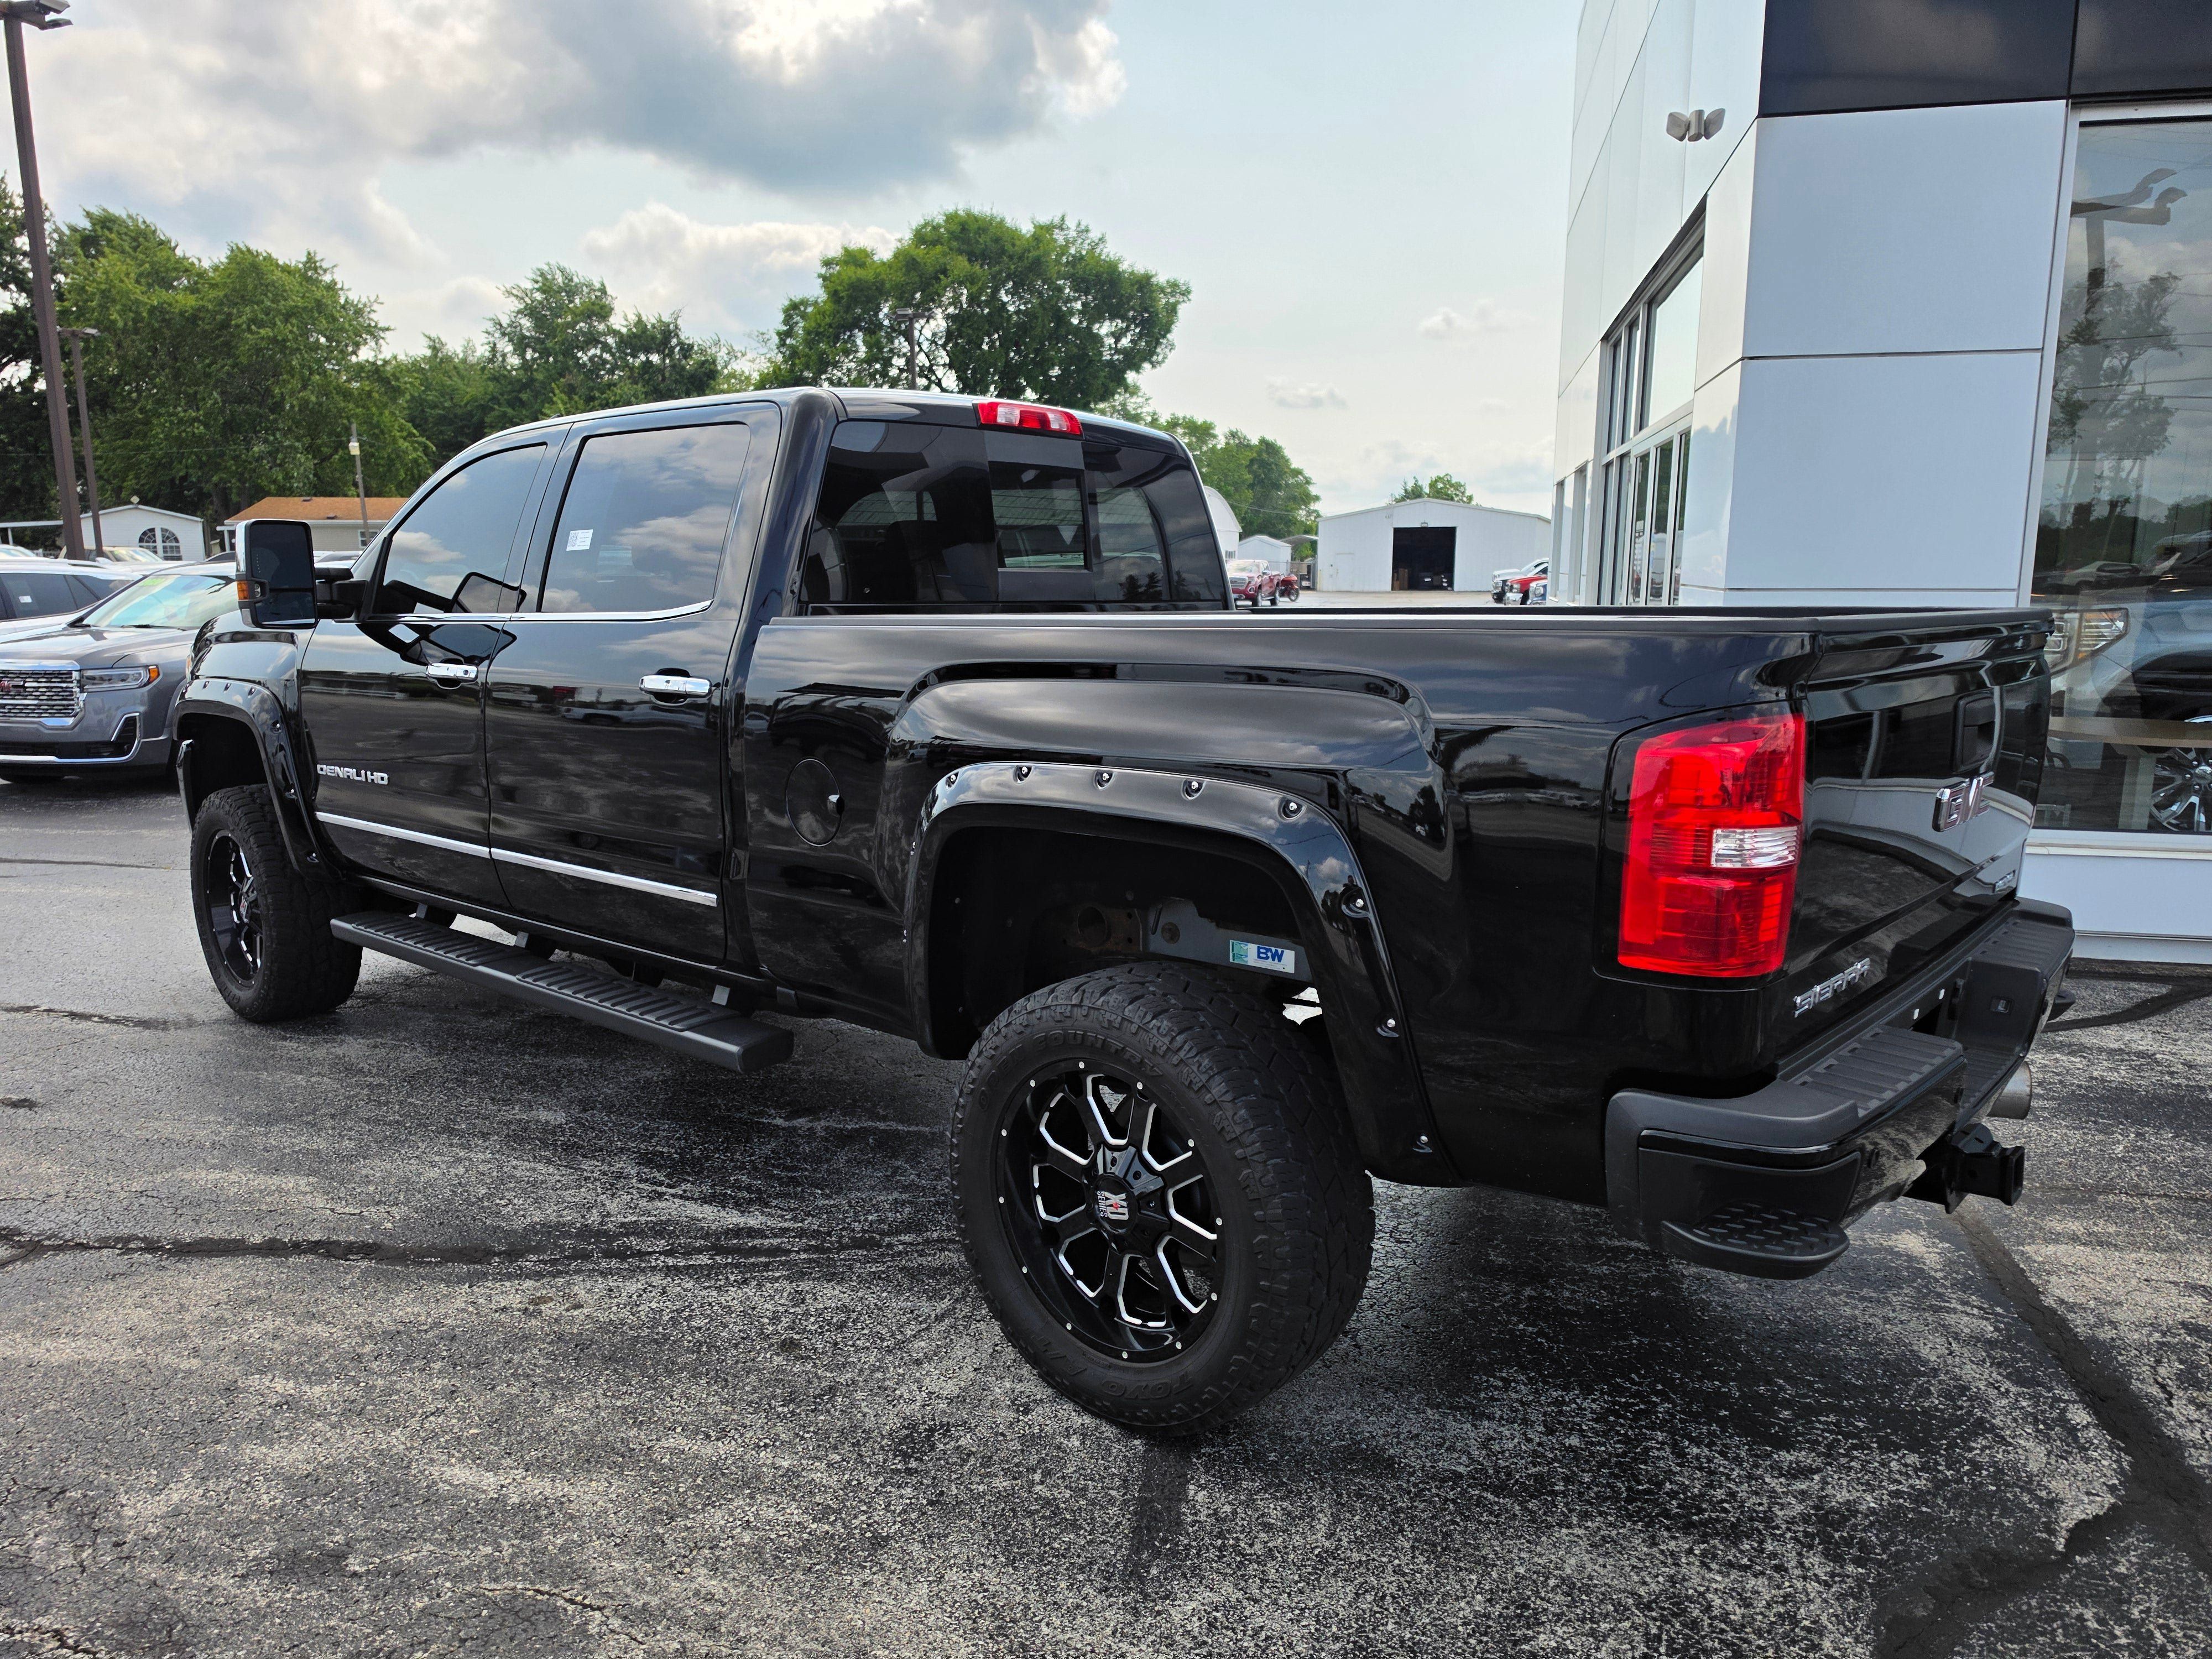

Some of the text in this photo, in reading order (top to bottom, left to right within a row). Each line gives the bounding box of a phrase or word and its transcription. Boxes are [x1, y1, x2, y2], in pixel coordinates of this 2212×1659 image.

[316, 764, 389, 785] DENALI HD
[1932, 771, 1994, 832] GMC
[1793, 957, 1871, 1018] SIERRA
[1032, 1030, 1164, 1076] COUNTRY
[1097, 1191, 1108, 1218] SERIES
[1104, 1191, 1129, 1220] XD
[1102, 1370, 1194, 1401] TOYO
